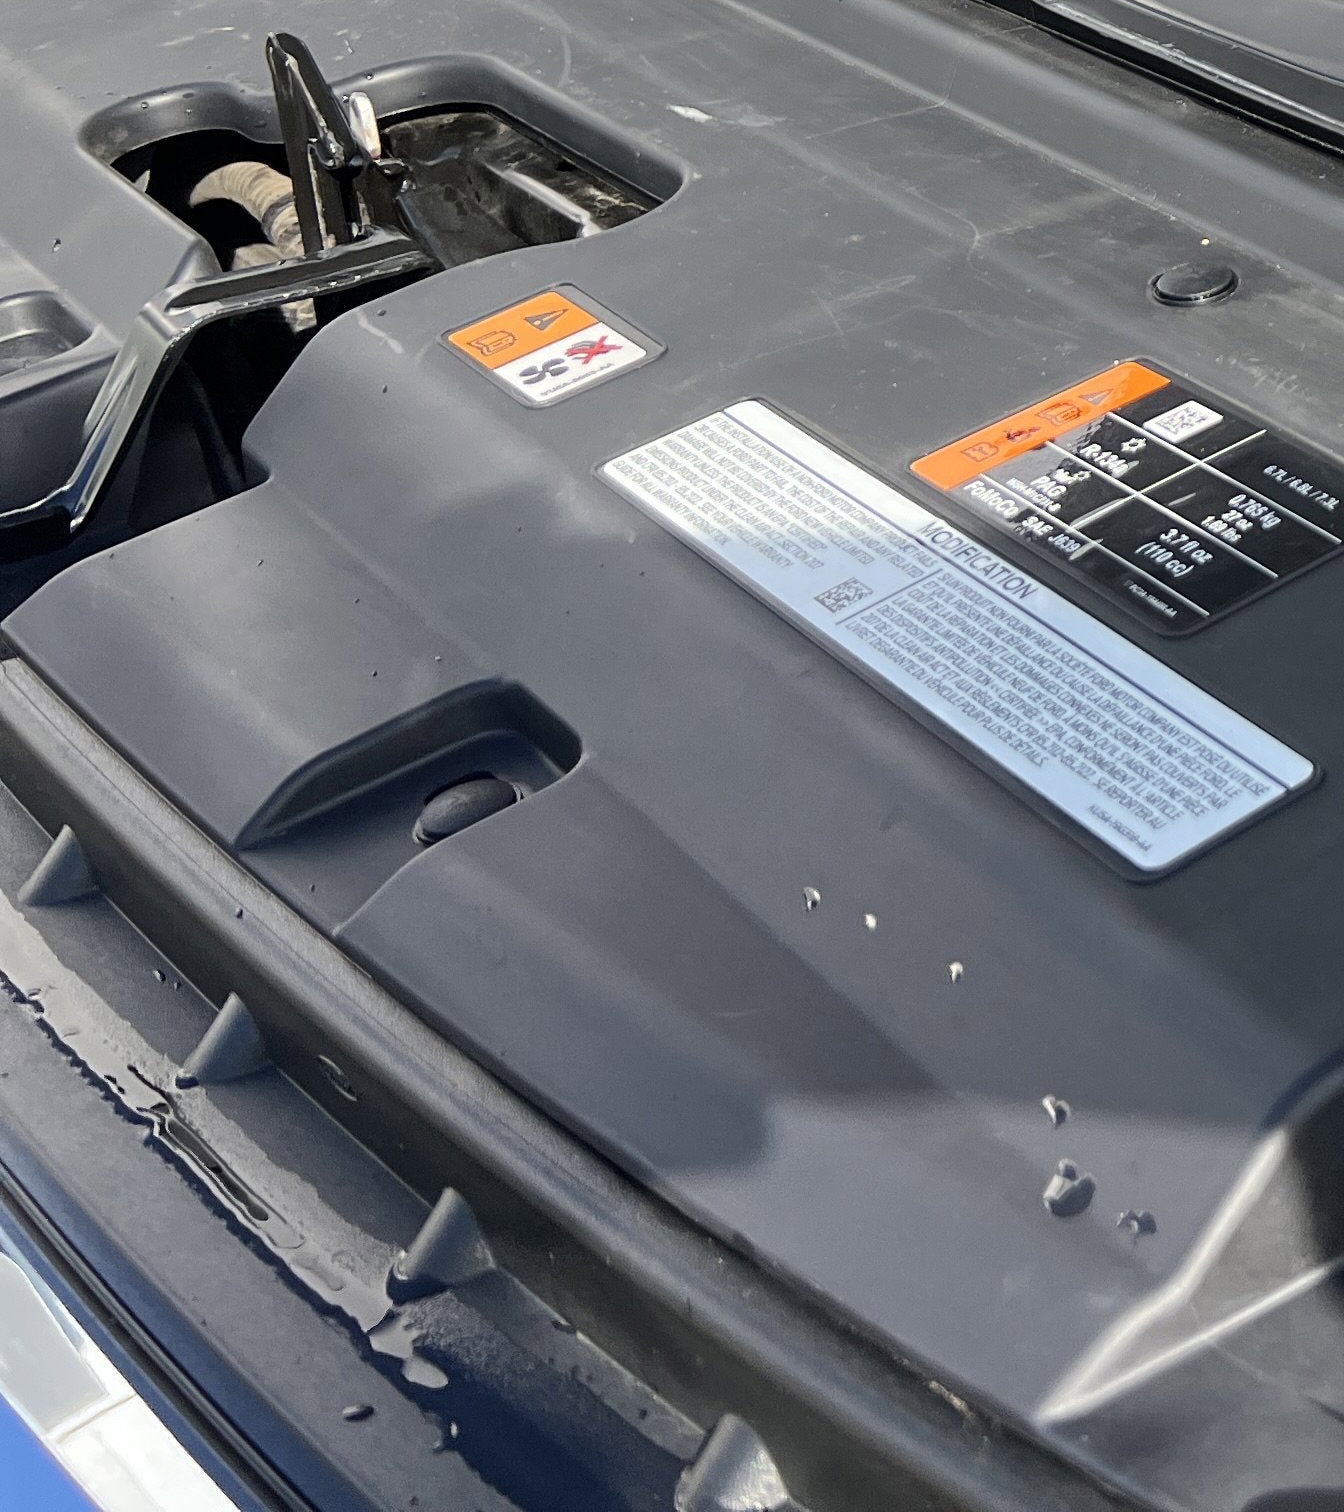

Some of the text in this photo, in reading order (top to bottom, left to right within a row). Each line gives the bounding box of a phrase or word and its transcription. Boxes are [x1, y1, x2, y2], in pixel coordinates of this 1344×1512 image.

[1079, 444, 1132, 473] R-134a
[1030, 476, 1066, 496] PAG
[961, 481, 1080, 552] FoMoCo SAE J639
[1221, 510, 1252, 529] 27 oz
[1228, 494, 1284, 528] 0.765 kg
[916, 521, 1038, 599] MODIFICATION
[1134, 542, 1194, 577] (110 cc)
[1158, 529, 1213, 563] 3.7 fl oz
